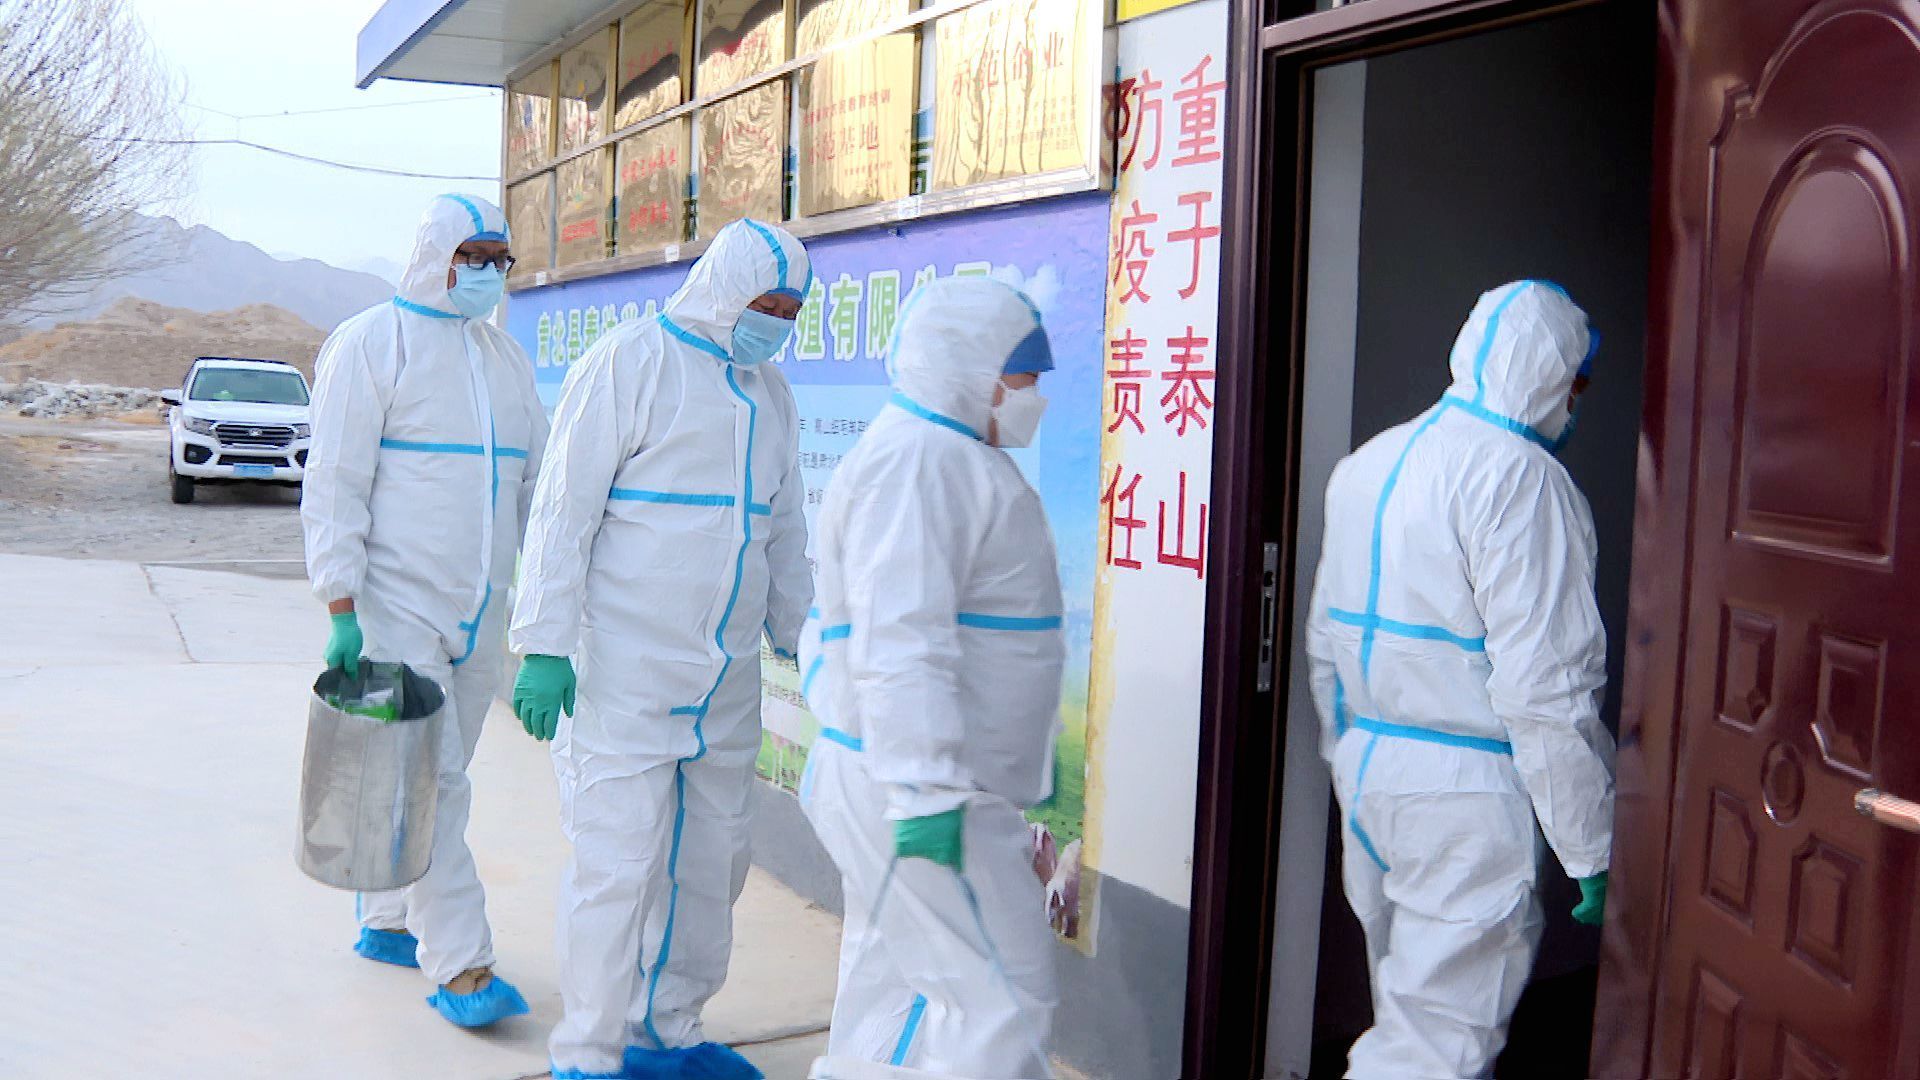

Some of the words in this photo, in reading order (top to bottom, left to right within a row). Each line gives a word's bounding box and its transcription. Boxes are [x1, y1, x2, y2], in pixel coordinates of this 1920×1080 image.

[1101, 68, 1163, 571] 防疫责任
[1157, 54, 1227, 579] 重于泰山
